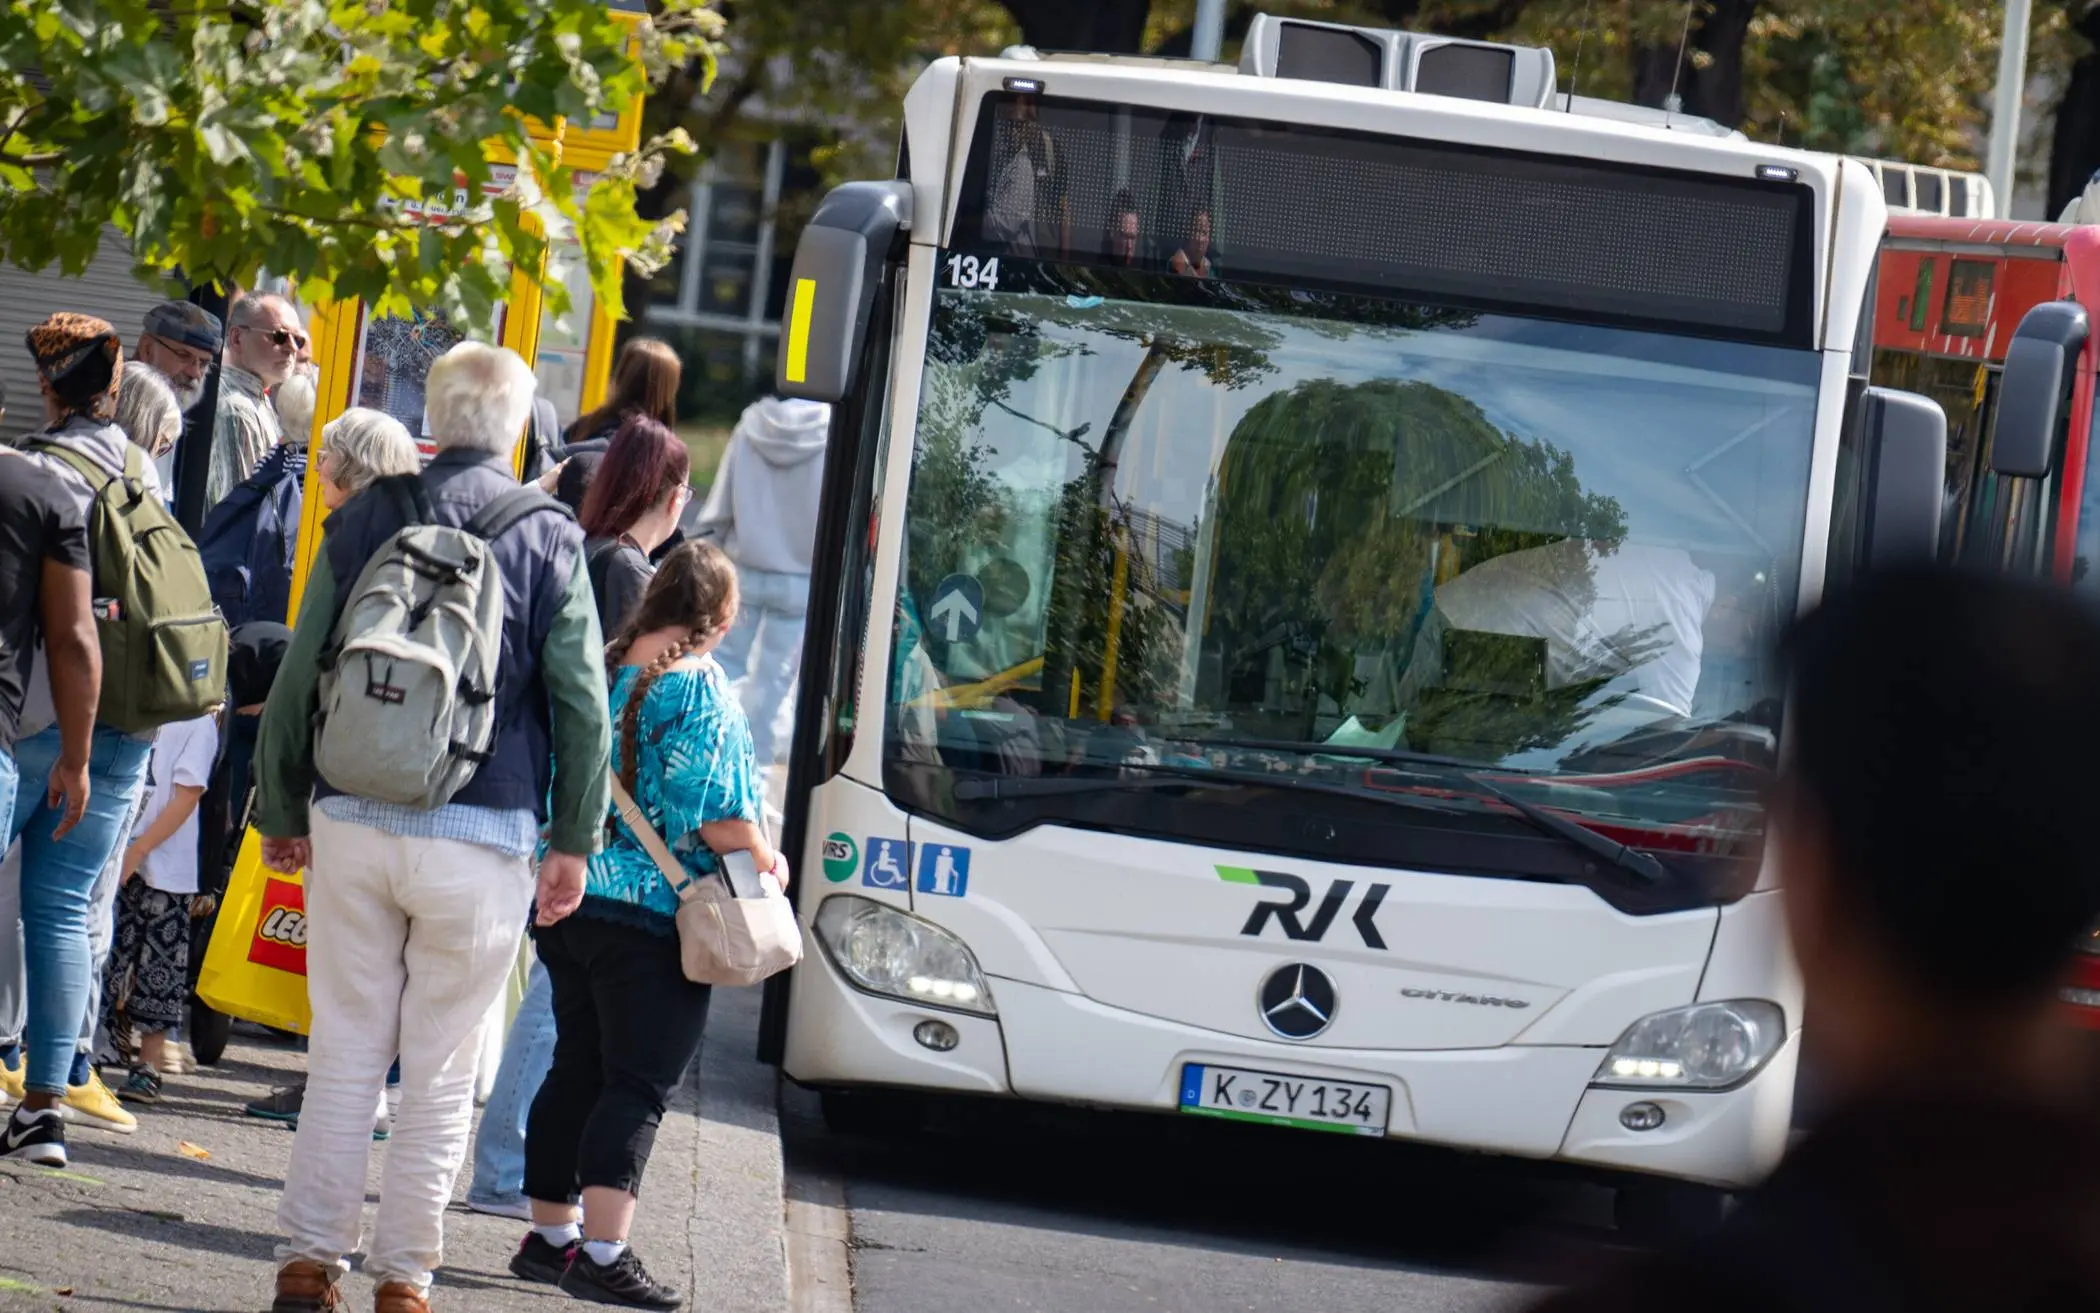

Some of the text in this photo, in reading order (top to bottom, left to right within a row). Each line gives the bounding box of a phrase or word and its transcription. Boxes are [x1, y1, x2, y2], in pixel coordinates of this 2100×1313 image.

[947, 253, 998, 290] 134
[260, 905, 308, 946] LEG
[1214, 864, 1392, 951] RVK
[1400, 988, 1531, 1010] CITARO
[1213, 1073, 1373, 1122] K ZY 134
